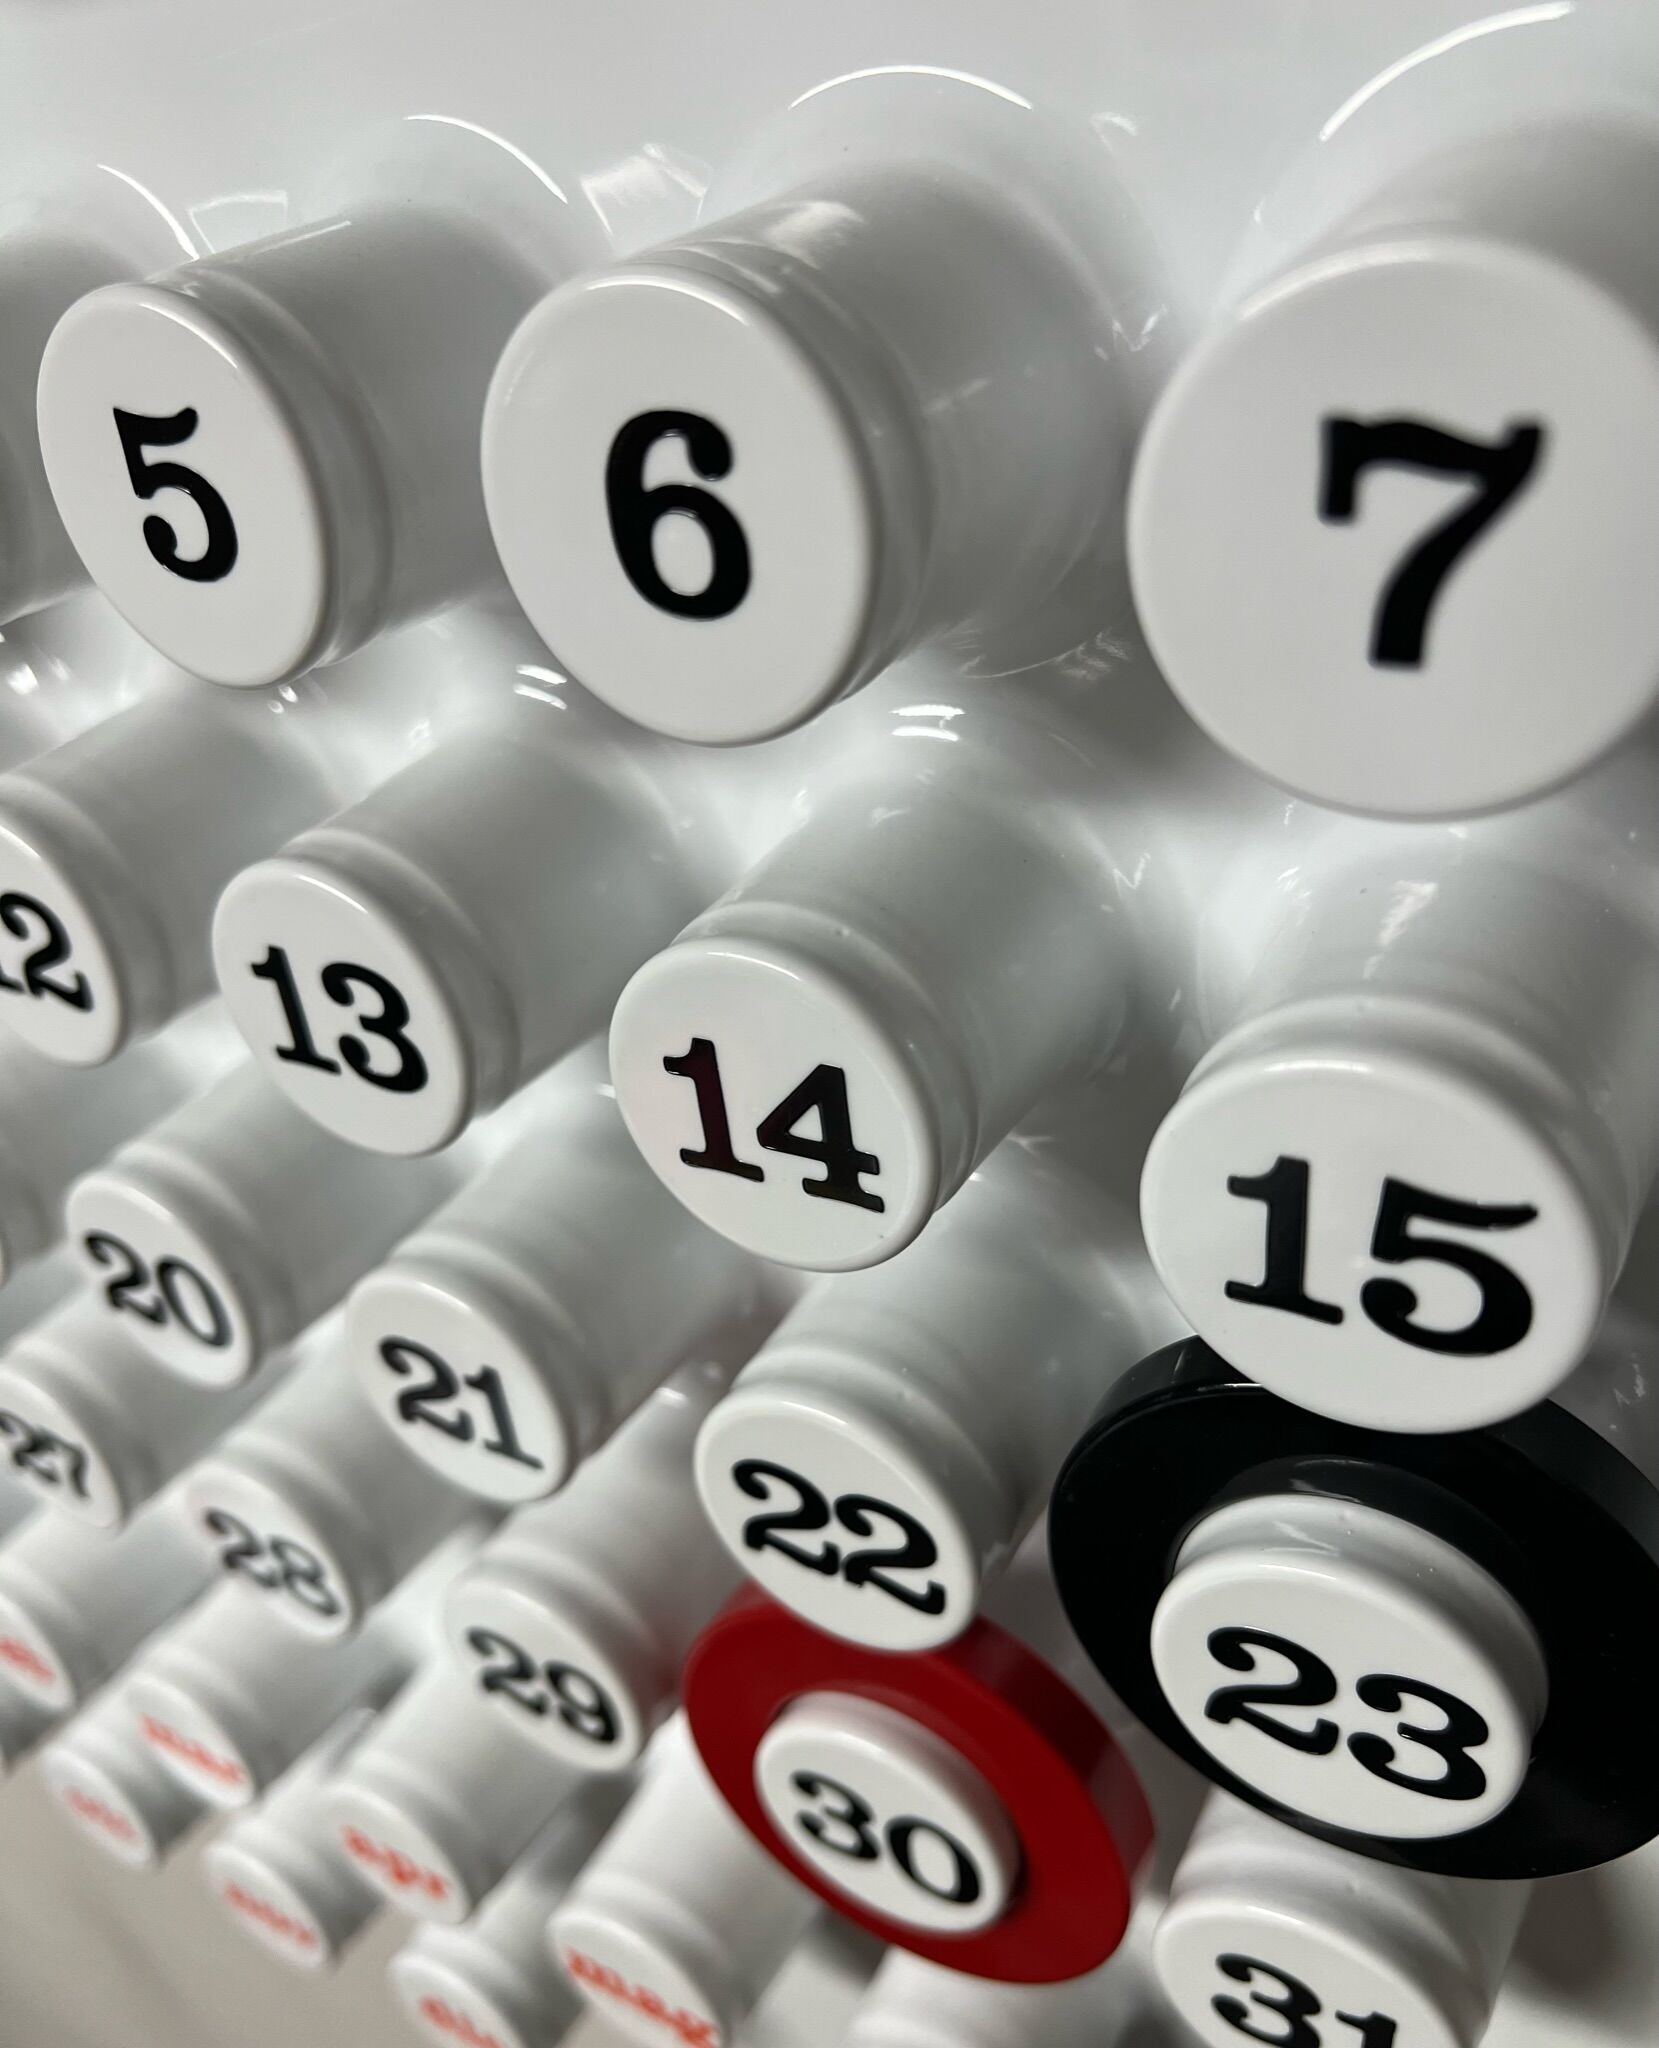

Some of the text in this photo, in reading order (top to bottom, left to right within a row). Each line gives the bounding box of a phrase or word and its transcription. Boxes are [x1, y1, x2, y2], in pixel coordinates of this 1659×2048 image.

[112, 406, 239, 583] 5
[604, 409, 753, 622] 6
[1318, 414, 1547, 672] 7
[0, 891, 93, 1012] 2
[250, 945, 429, 1094] 13
[662, 1037, 886, 1214] 14
[83, 1231, 231, 1348] 20
[1224, 1155, 1539, 1358] 15
[378, 1336, 543, 1470] 21
[203, 1508, 342, 1618] 28
[731, 1458, 947, 1616] 22
[468, 1630, 621, 1747] 29
[1204, 1626, 1490, 1802] 23
[792, 1772, 982, 1907] 30
